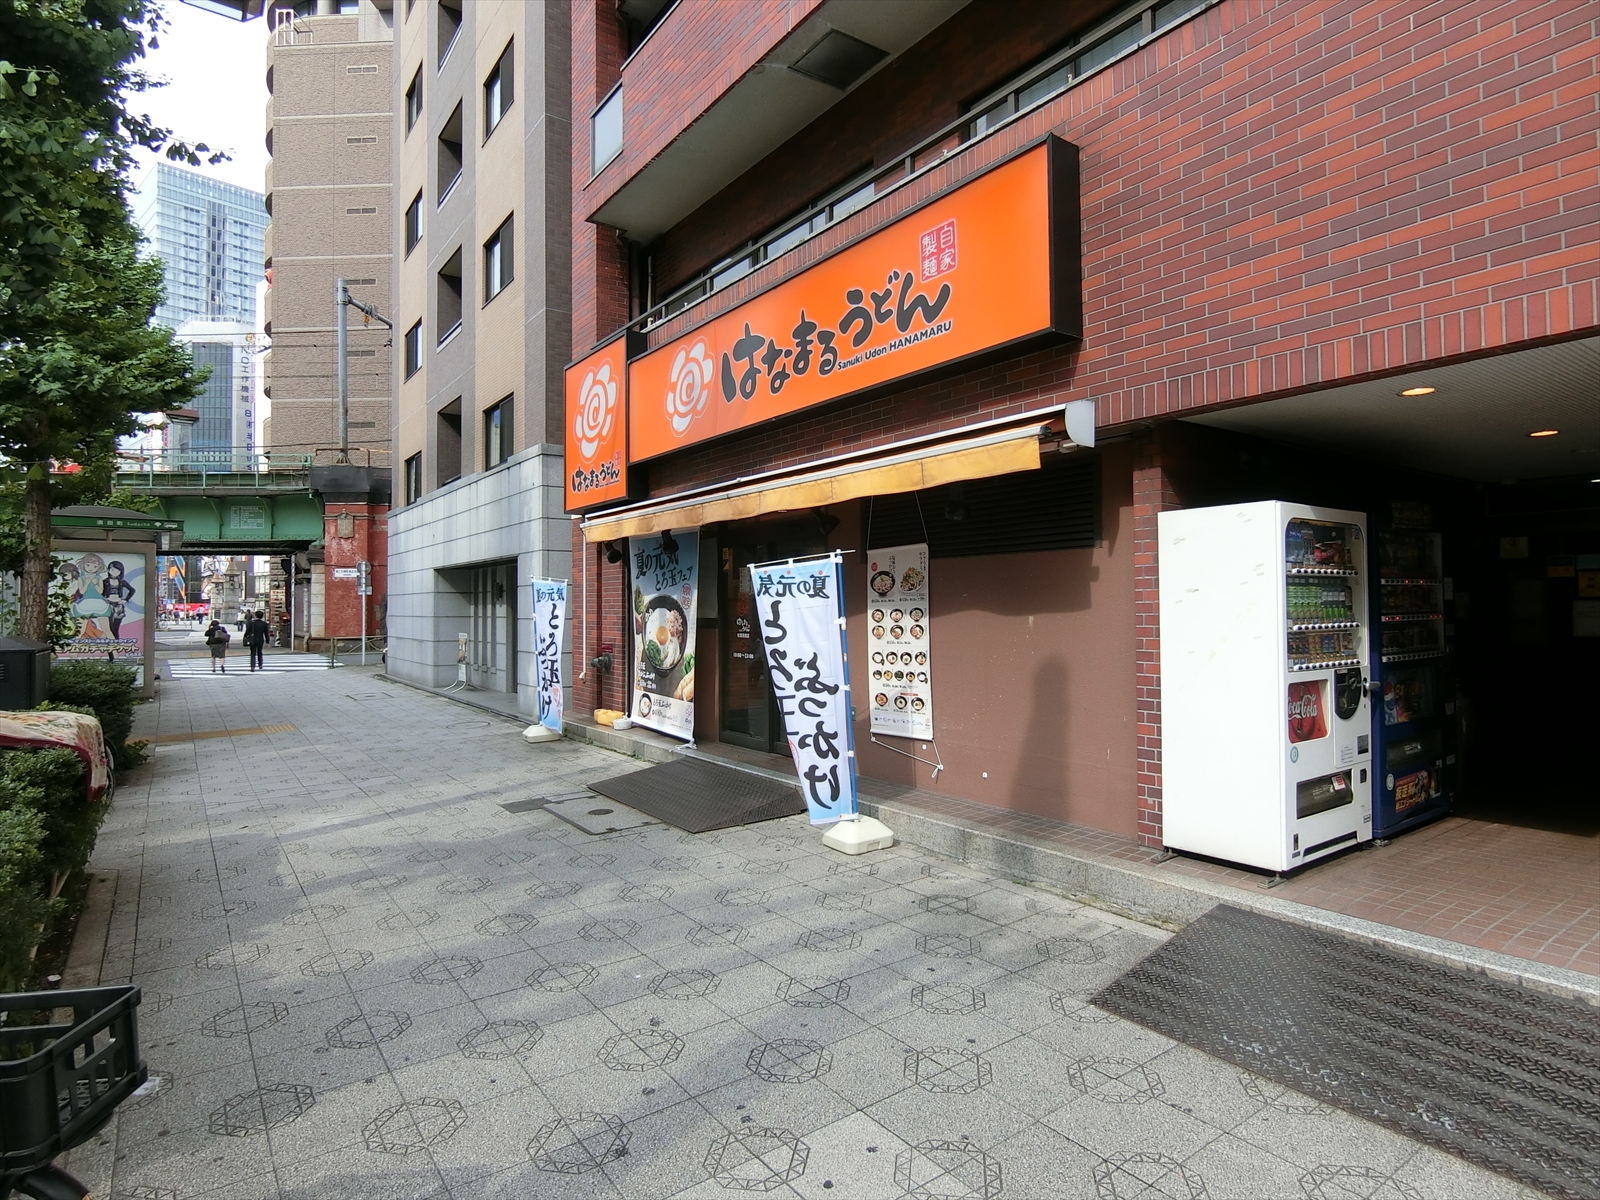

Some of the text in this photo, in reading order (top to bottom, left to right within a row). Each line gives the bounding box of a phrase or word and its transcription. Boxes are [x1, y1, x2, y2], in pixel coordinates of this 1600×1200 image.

[922, 230, 938, 281] 製麺
[940, 225, 955, 271] 自家
[721, 270, 951, 403] はなまるうどん
[837, 320, 952, 371] Sanuki Udon HANAMARU
[571, 461, 621, 492] はなまるうどん
[654, 565, 694, 592] とろ玉フェア
[545, 602, 561, 685] とろ玉
